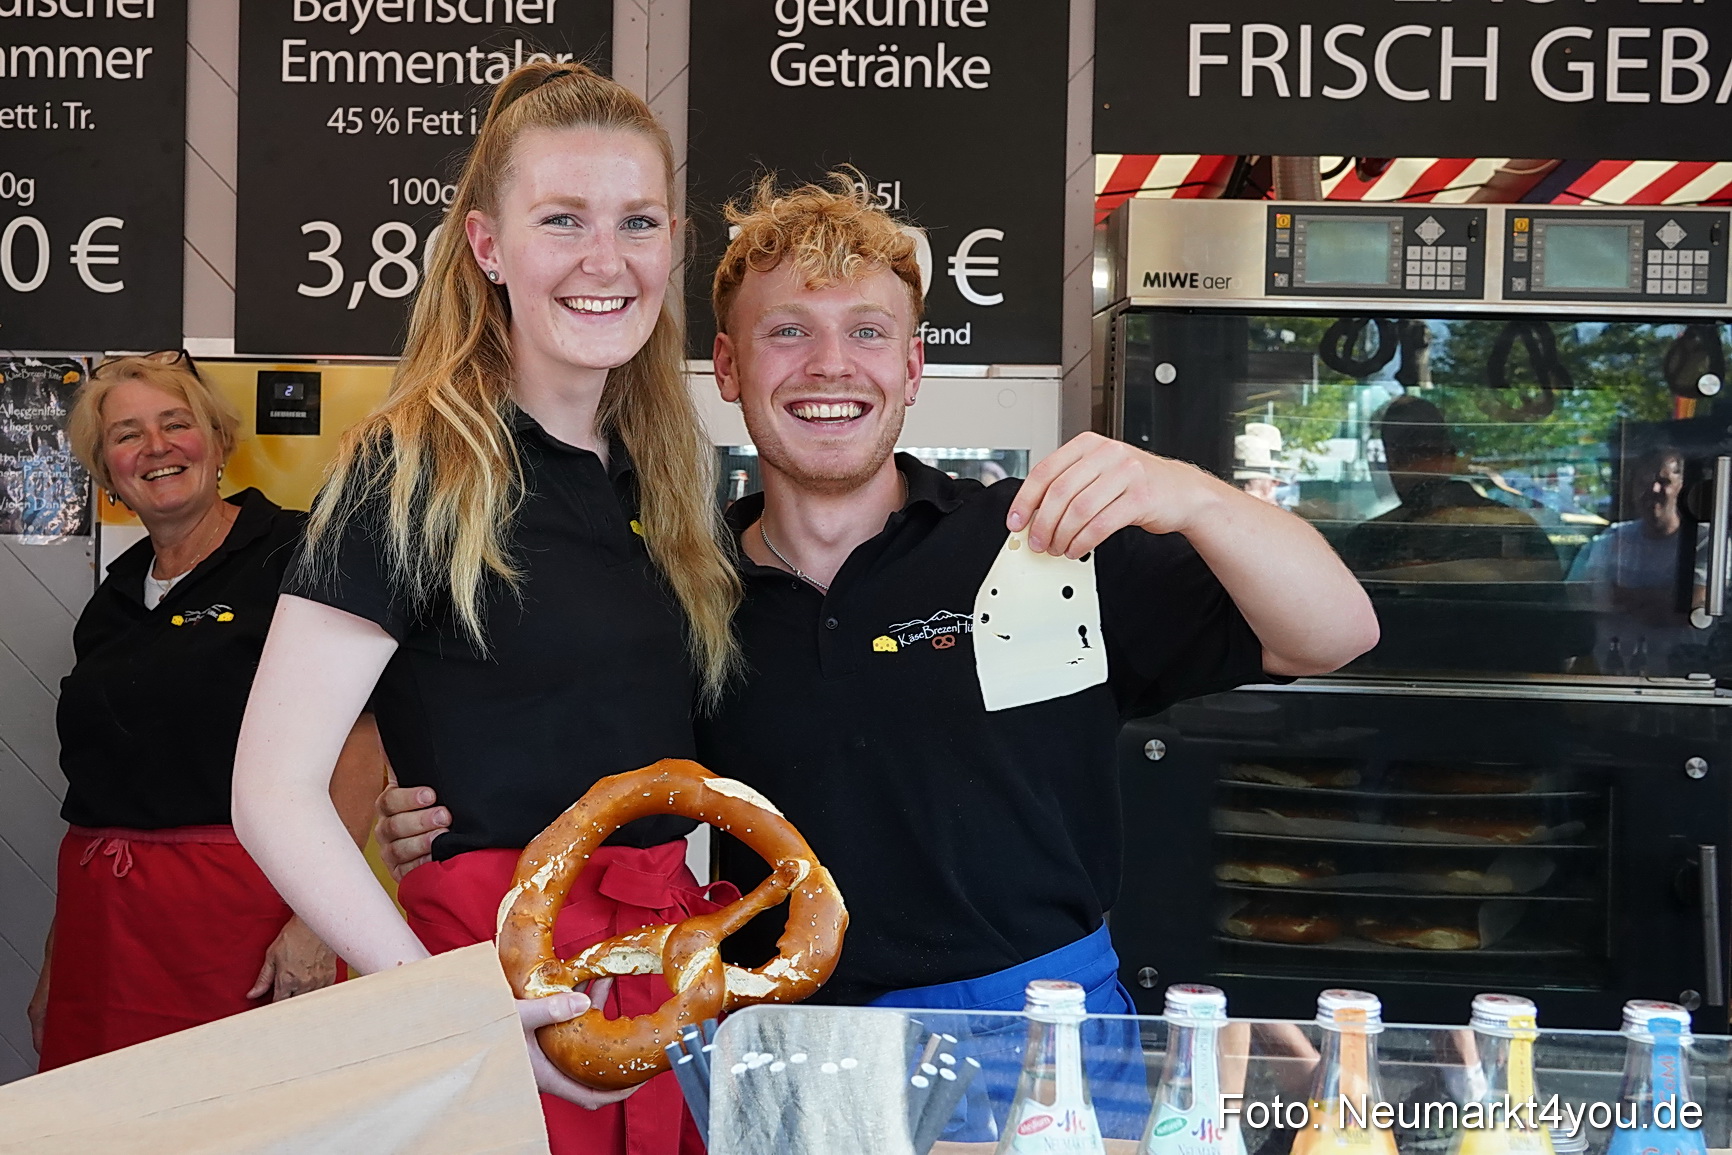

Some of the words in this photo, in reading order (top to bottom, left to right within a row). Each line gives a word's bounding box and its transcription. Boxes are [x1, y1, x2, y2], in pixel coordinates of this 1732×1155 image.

[0, 45, 153, 79] mmer
[770, 42, 991, 89] Getränke
[1188, 24, 1499, 101] FRISCH
[1531, 26, 1732, 104] GEB
[45, 102, 59, 129] i.
[62, 102, 95, 130] Tr.
[326, 107, 363, 134] 45
[370, 107, 400, 135] %
[407, 107, 463, 135] Fett
[70, 216, 124, 293] €
[947, 228, 1005, 306] €
[1143, 271, 1200, 288] MIWE
[916, 321, 971, 345] fand
[284, 385, 294, 397] 2
